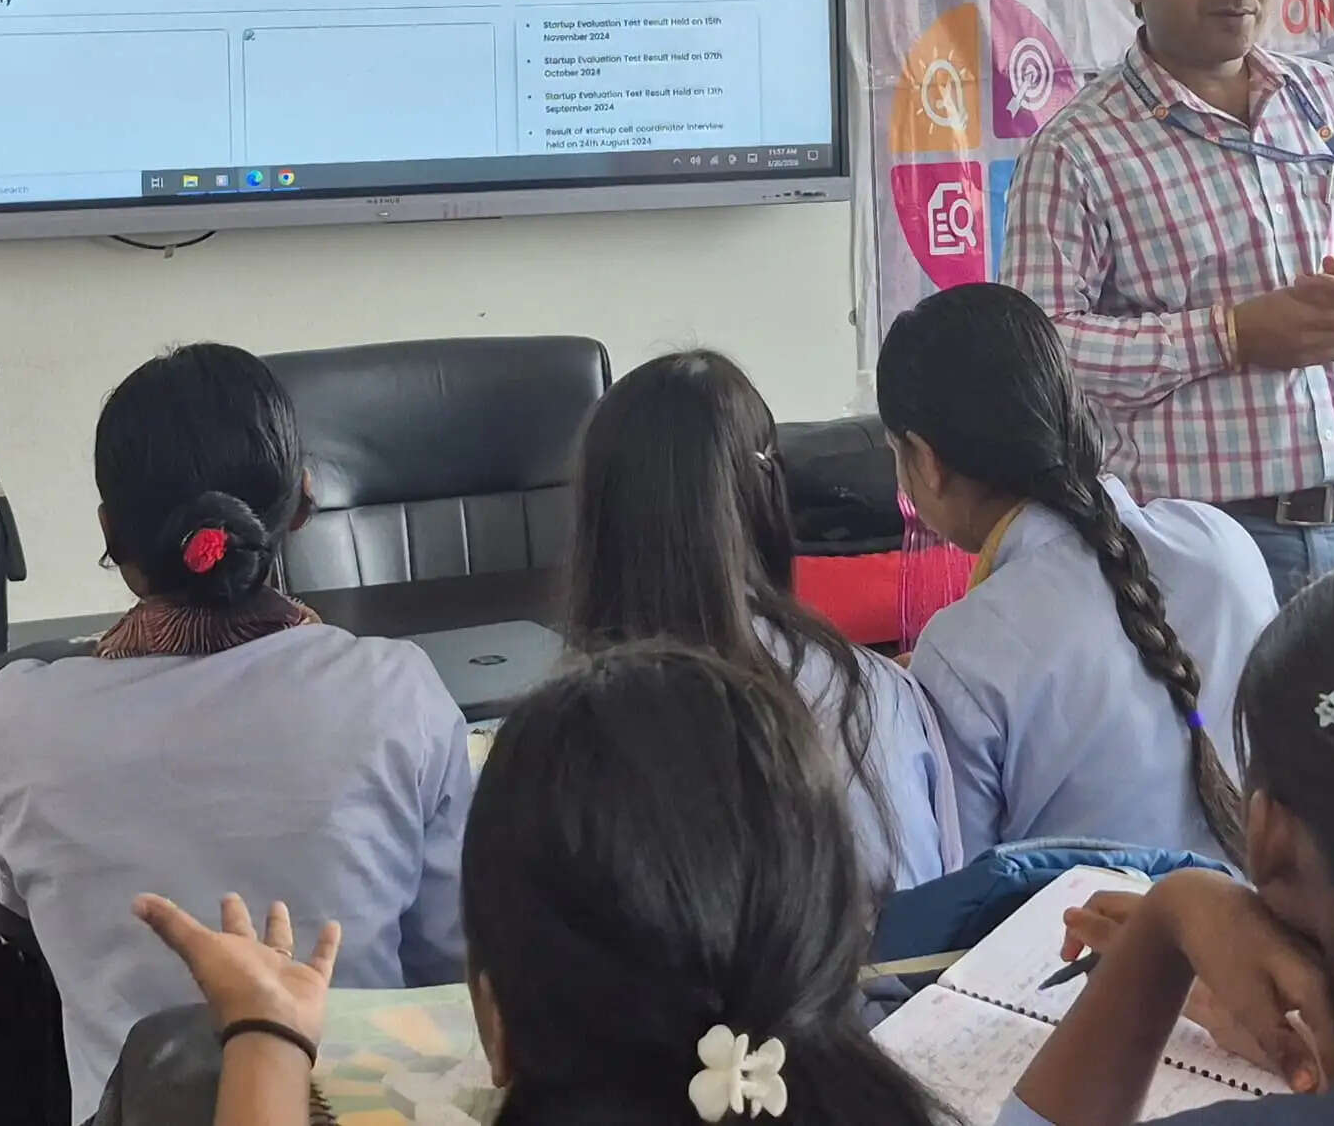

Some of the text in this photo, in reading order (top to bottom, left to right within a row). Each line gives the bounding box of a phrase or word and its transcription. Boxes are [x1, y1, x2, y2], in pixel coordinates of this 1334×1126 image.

[543, 20, 575, 30] Startup
[577, 19, 622, 28] Evaluation
[624, 18, 641, 27] Test
[643, 17, 669, 27] Result
[543, 32, 610, 42] November 2024
[544, 56, 576, 66] Startup
[578, 55, 622, 64] Evaluation
[624, 54, 641, 63] Test
[544, 68, 579, 78] October
[545, 91, 577, 101] Startup
[579, 90, 623, 99] Evaluation
[625, 89, 642, 98] Test
[645, 89, 671, 97] Result
[545, 103, 615, 114] September 2024
[545, 127, 572, 136] Result
[574, 127, 583, 135] of
[585, 126, 616, 136] startup
[618, 125, 634, 134] cell
[635, 124, 685, 133] coordinator
[545, 140, 565, 149] held
[566, 141, 578, 149] on
[600, 138, 630, 148] August
[631, 137, 652, 146] 2024
